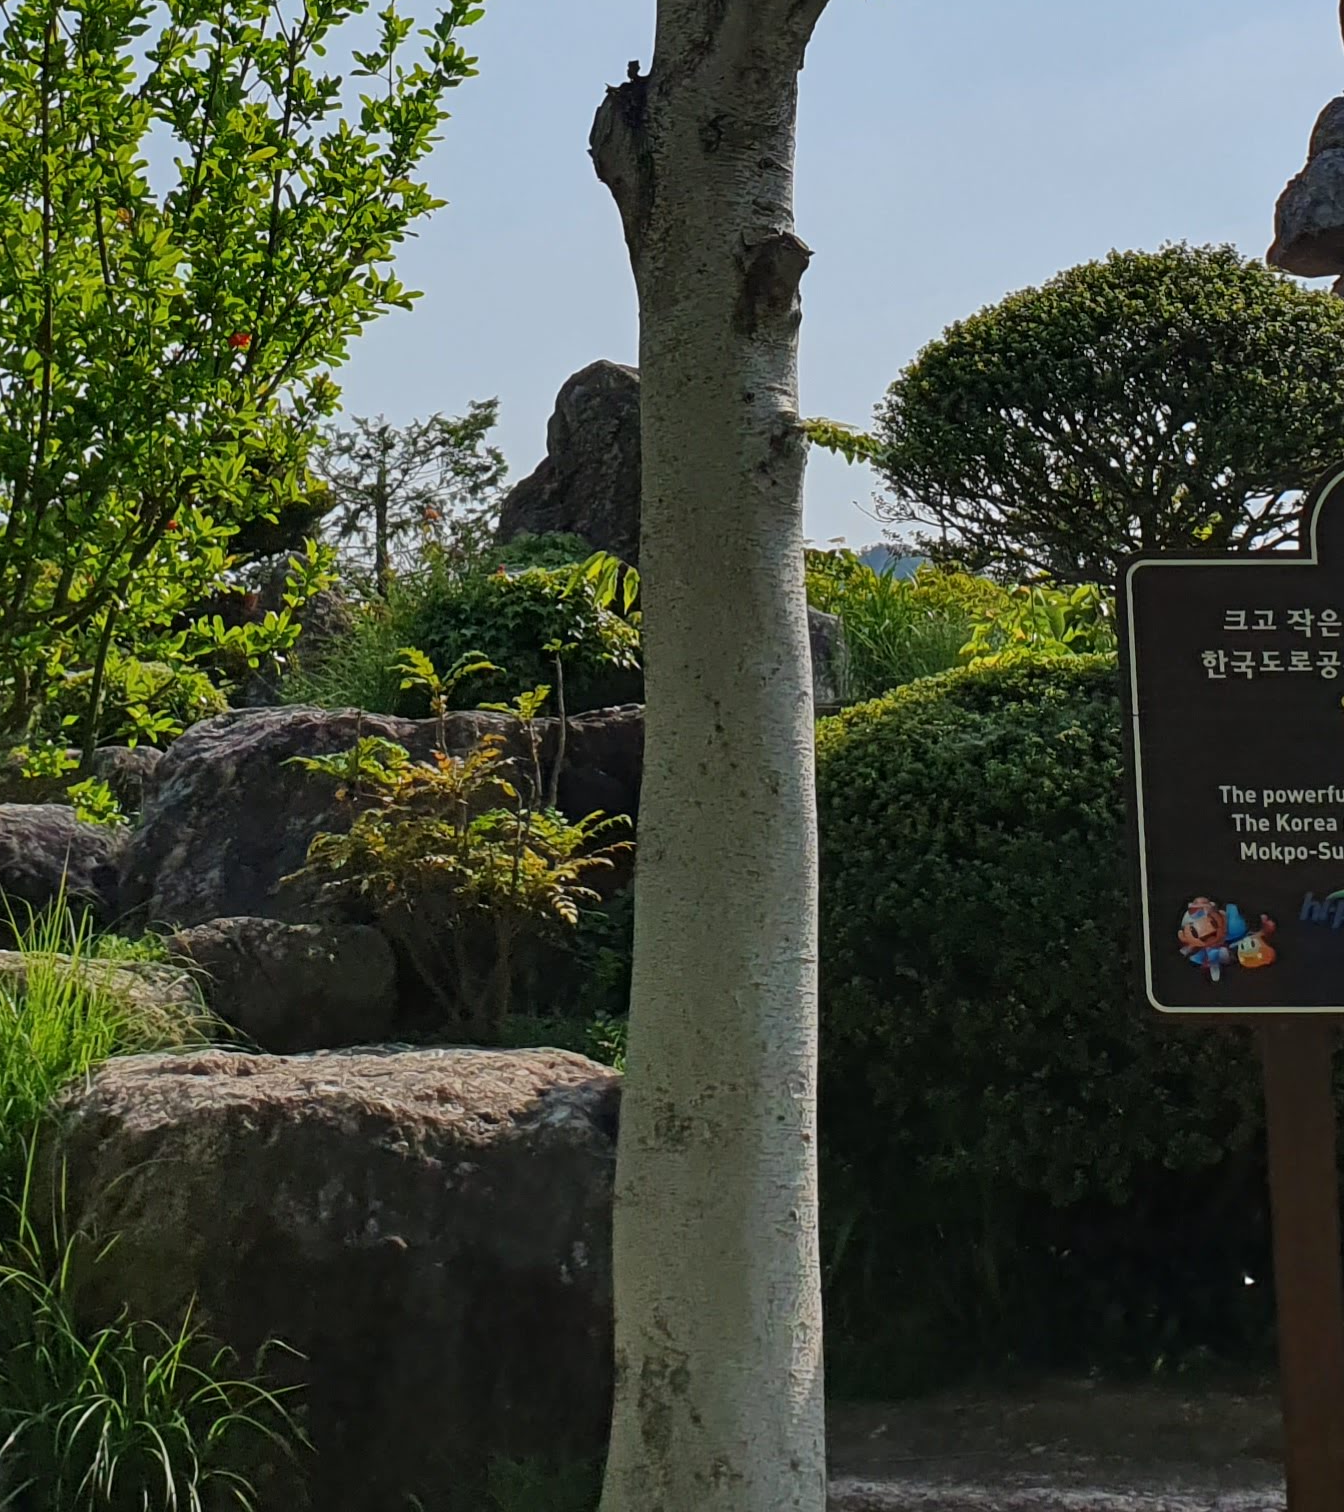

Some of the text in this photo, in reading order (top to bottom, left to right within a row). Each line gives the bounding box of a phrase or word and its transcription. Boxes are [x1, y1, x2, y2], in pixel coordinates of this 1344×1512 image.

[1223, 610, 1277, 630] 크고
[1287, 608, 1342, 638] 작은
[1218, 785, 1257, 804] The
[1231, 813, 1270, 832] The
[1276, 813, 1338, 832] Korea
